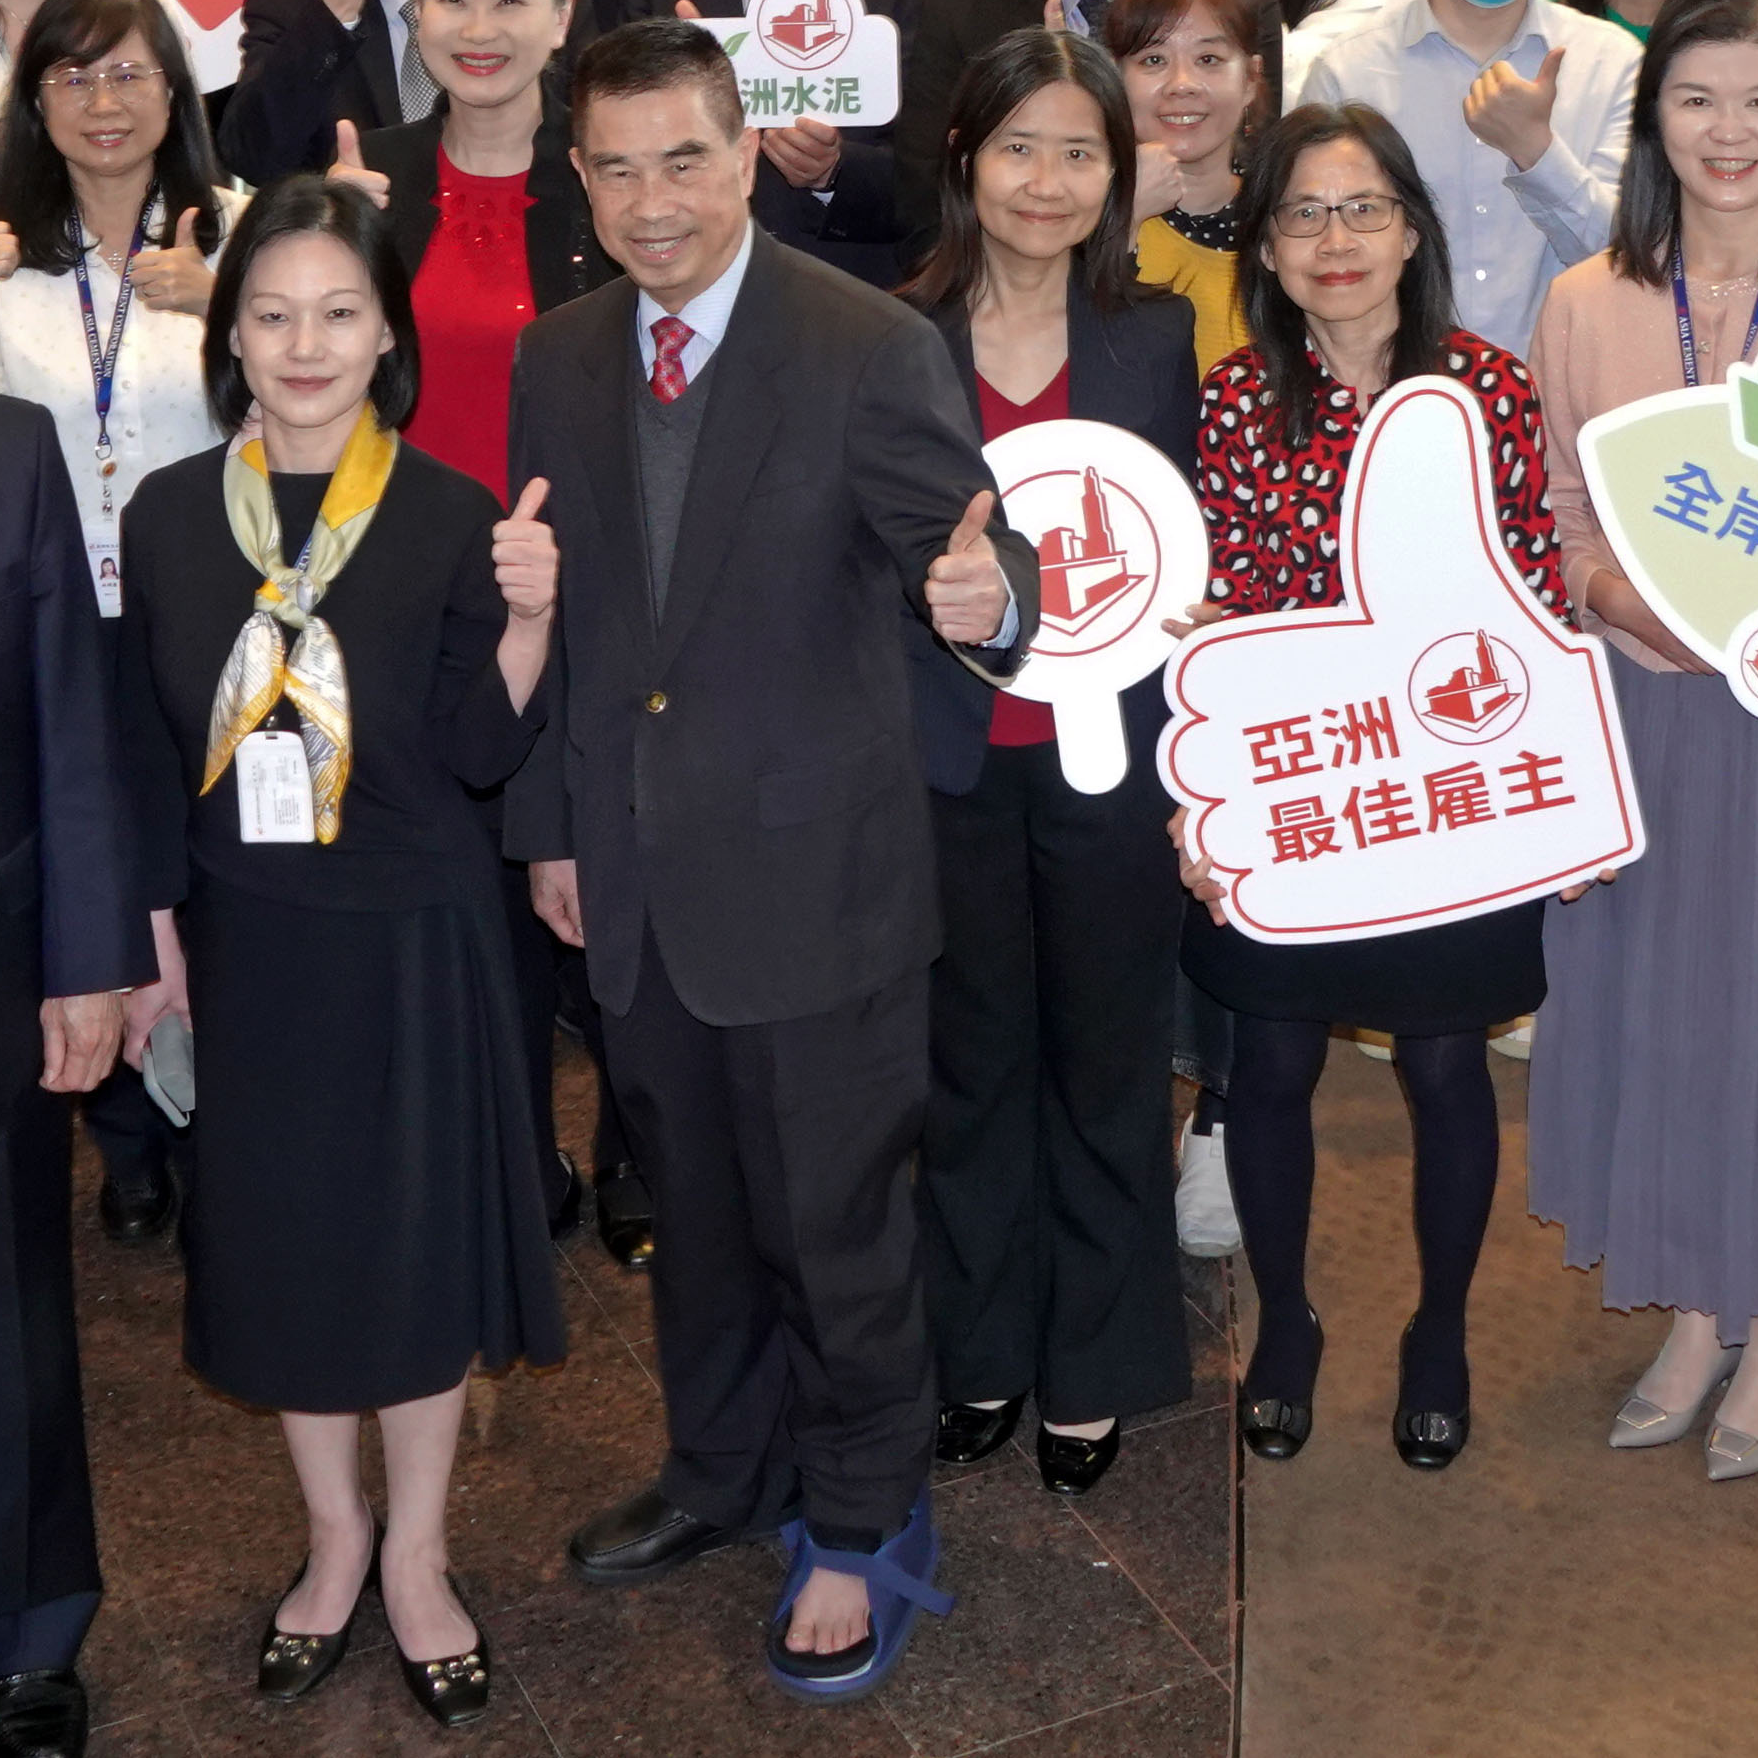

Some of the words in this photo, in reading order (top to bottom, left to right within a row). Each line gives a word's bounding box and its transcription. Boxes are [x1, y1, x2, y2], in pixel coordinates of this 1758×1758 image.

[740, 77, 862, 117] 洲水泥
[1678, 316, 1690, 338] ASIA
[1242, 696, 1401, 785] 亞洲
[1266, 750, 1577, 863] 最佳雇主
